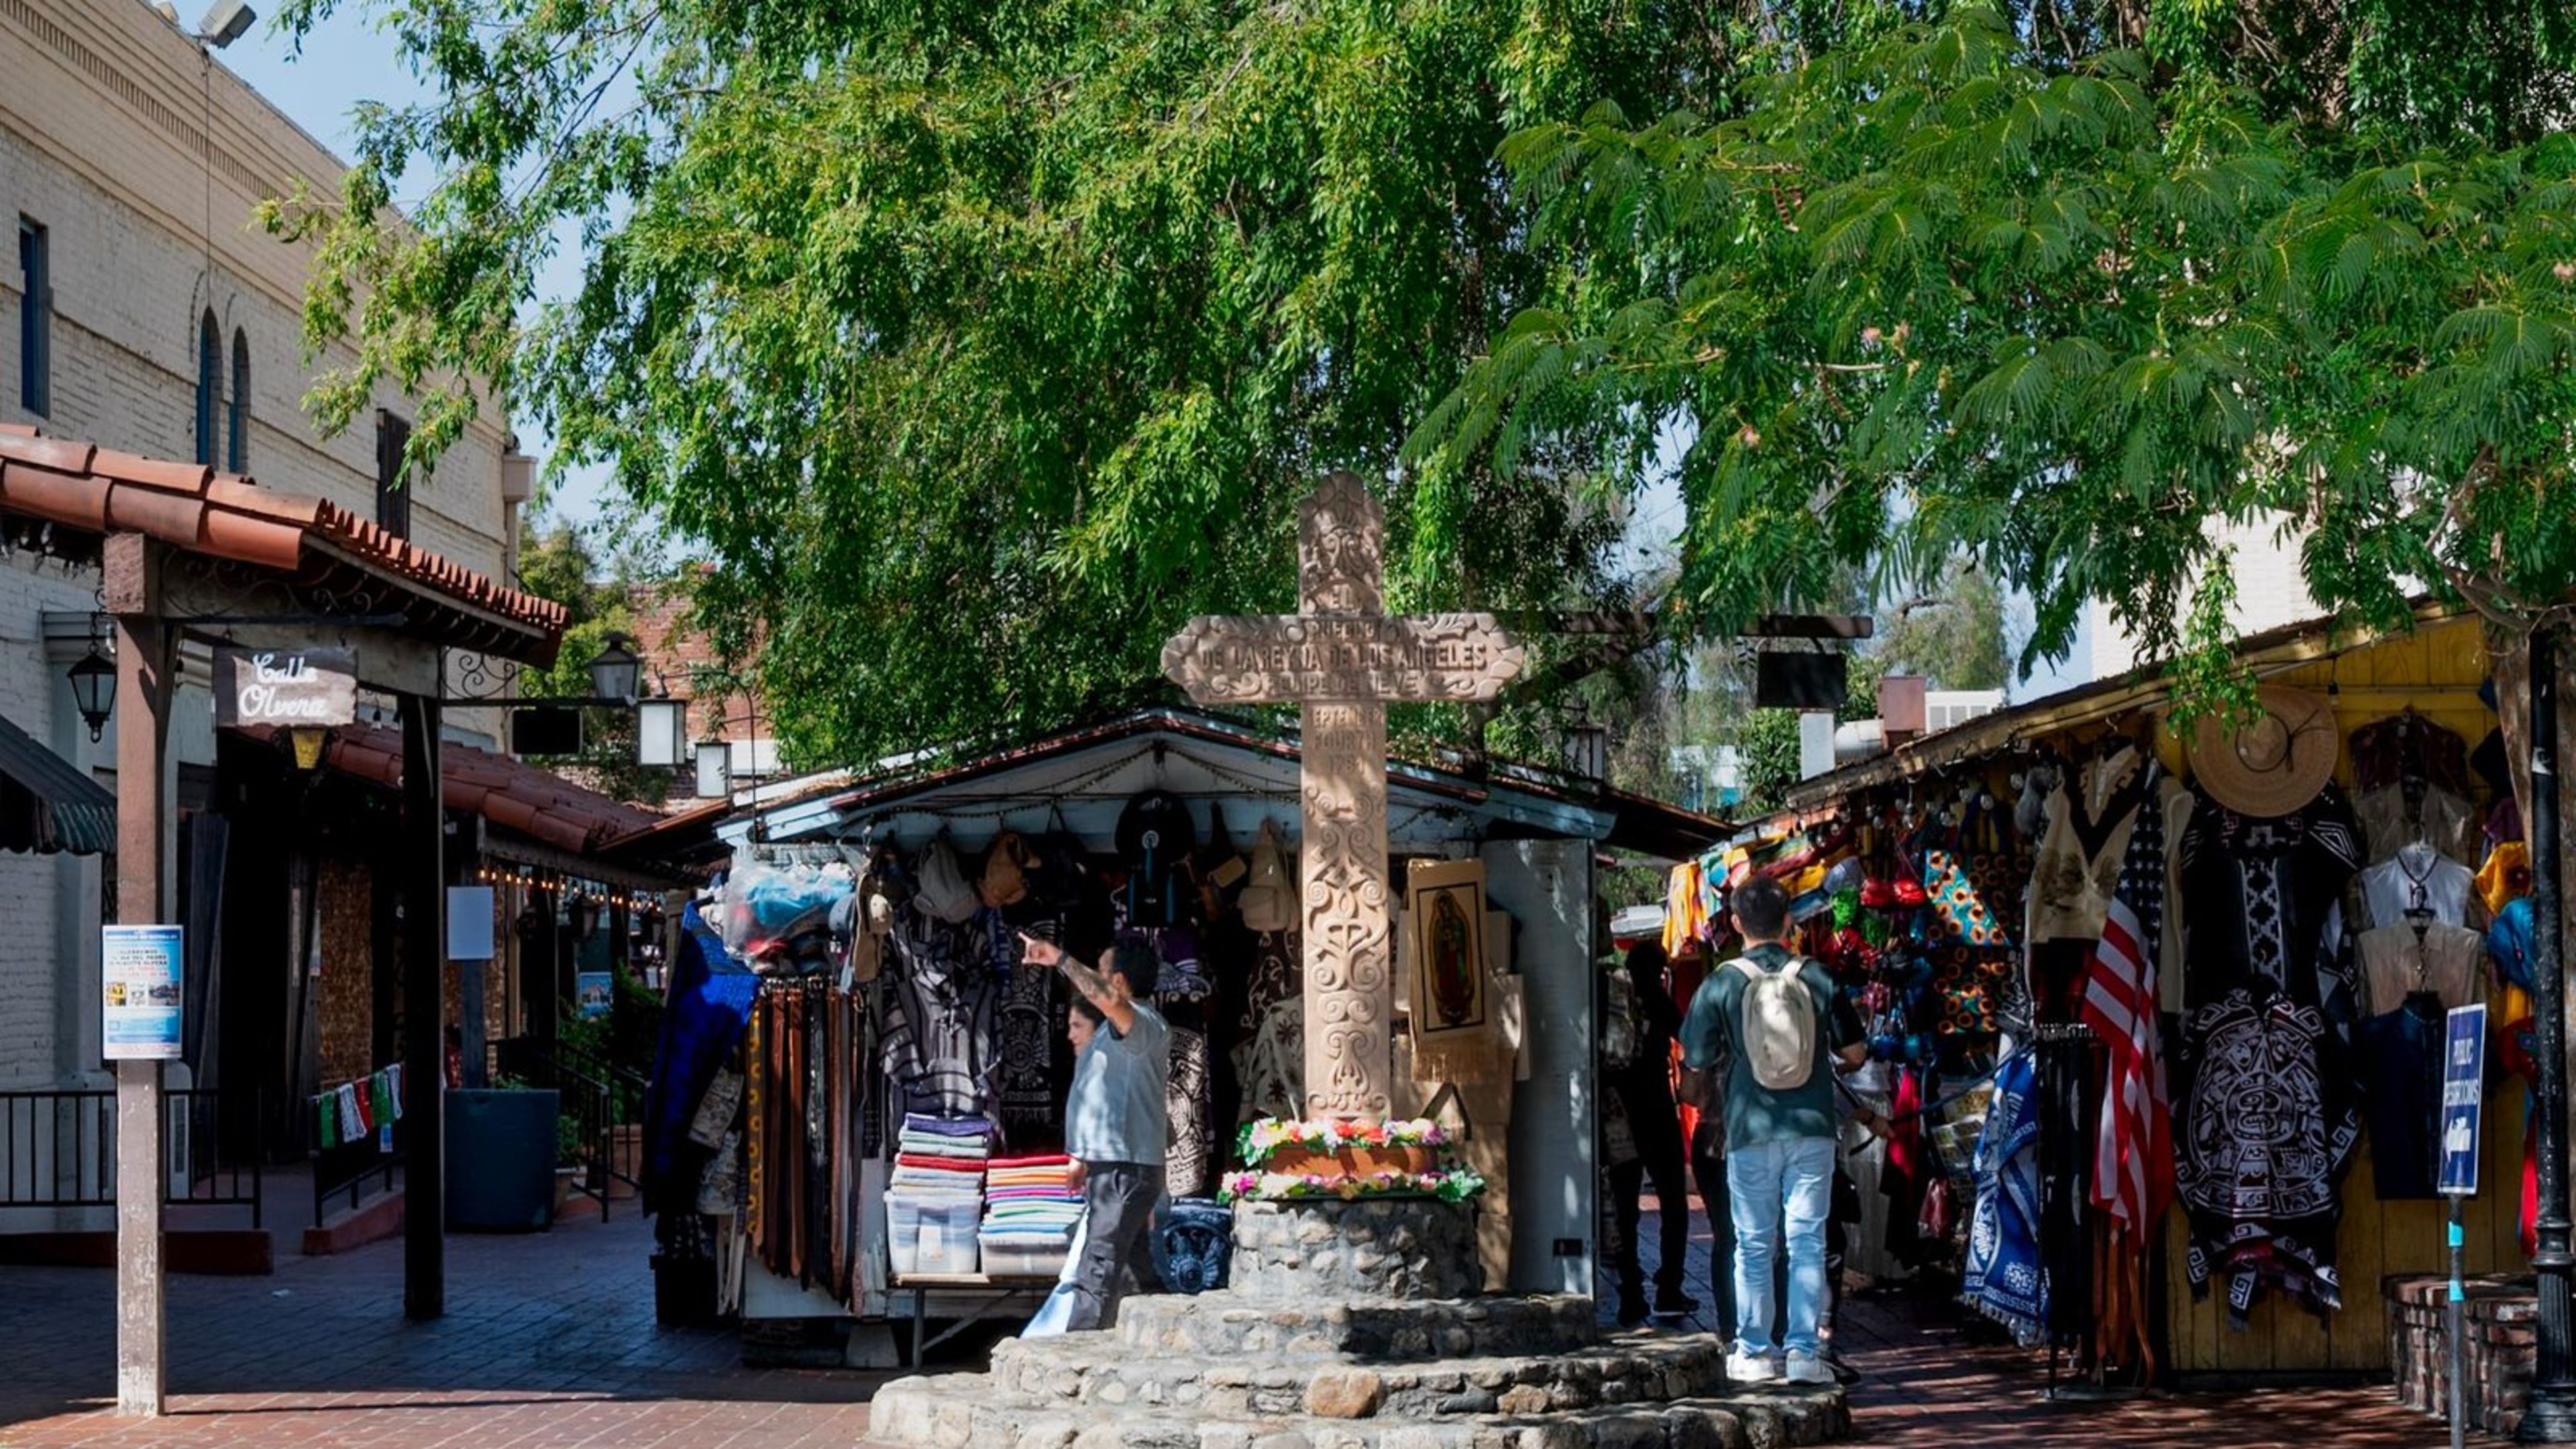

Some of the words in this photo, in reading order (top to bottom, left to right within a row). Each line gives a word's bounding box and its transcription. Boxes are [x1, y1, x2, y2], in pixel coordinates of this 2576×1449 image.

[252, 653, 318, 683] Calle
[1393, 643, 1487, 670] ANGELES
[239, 684, 329, 717] Olvera
